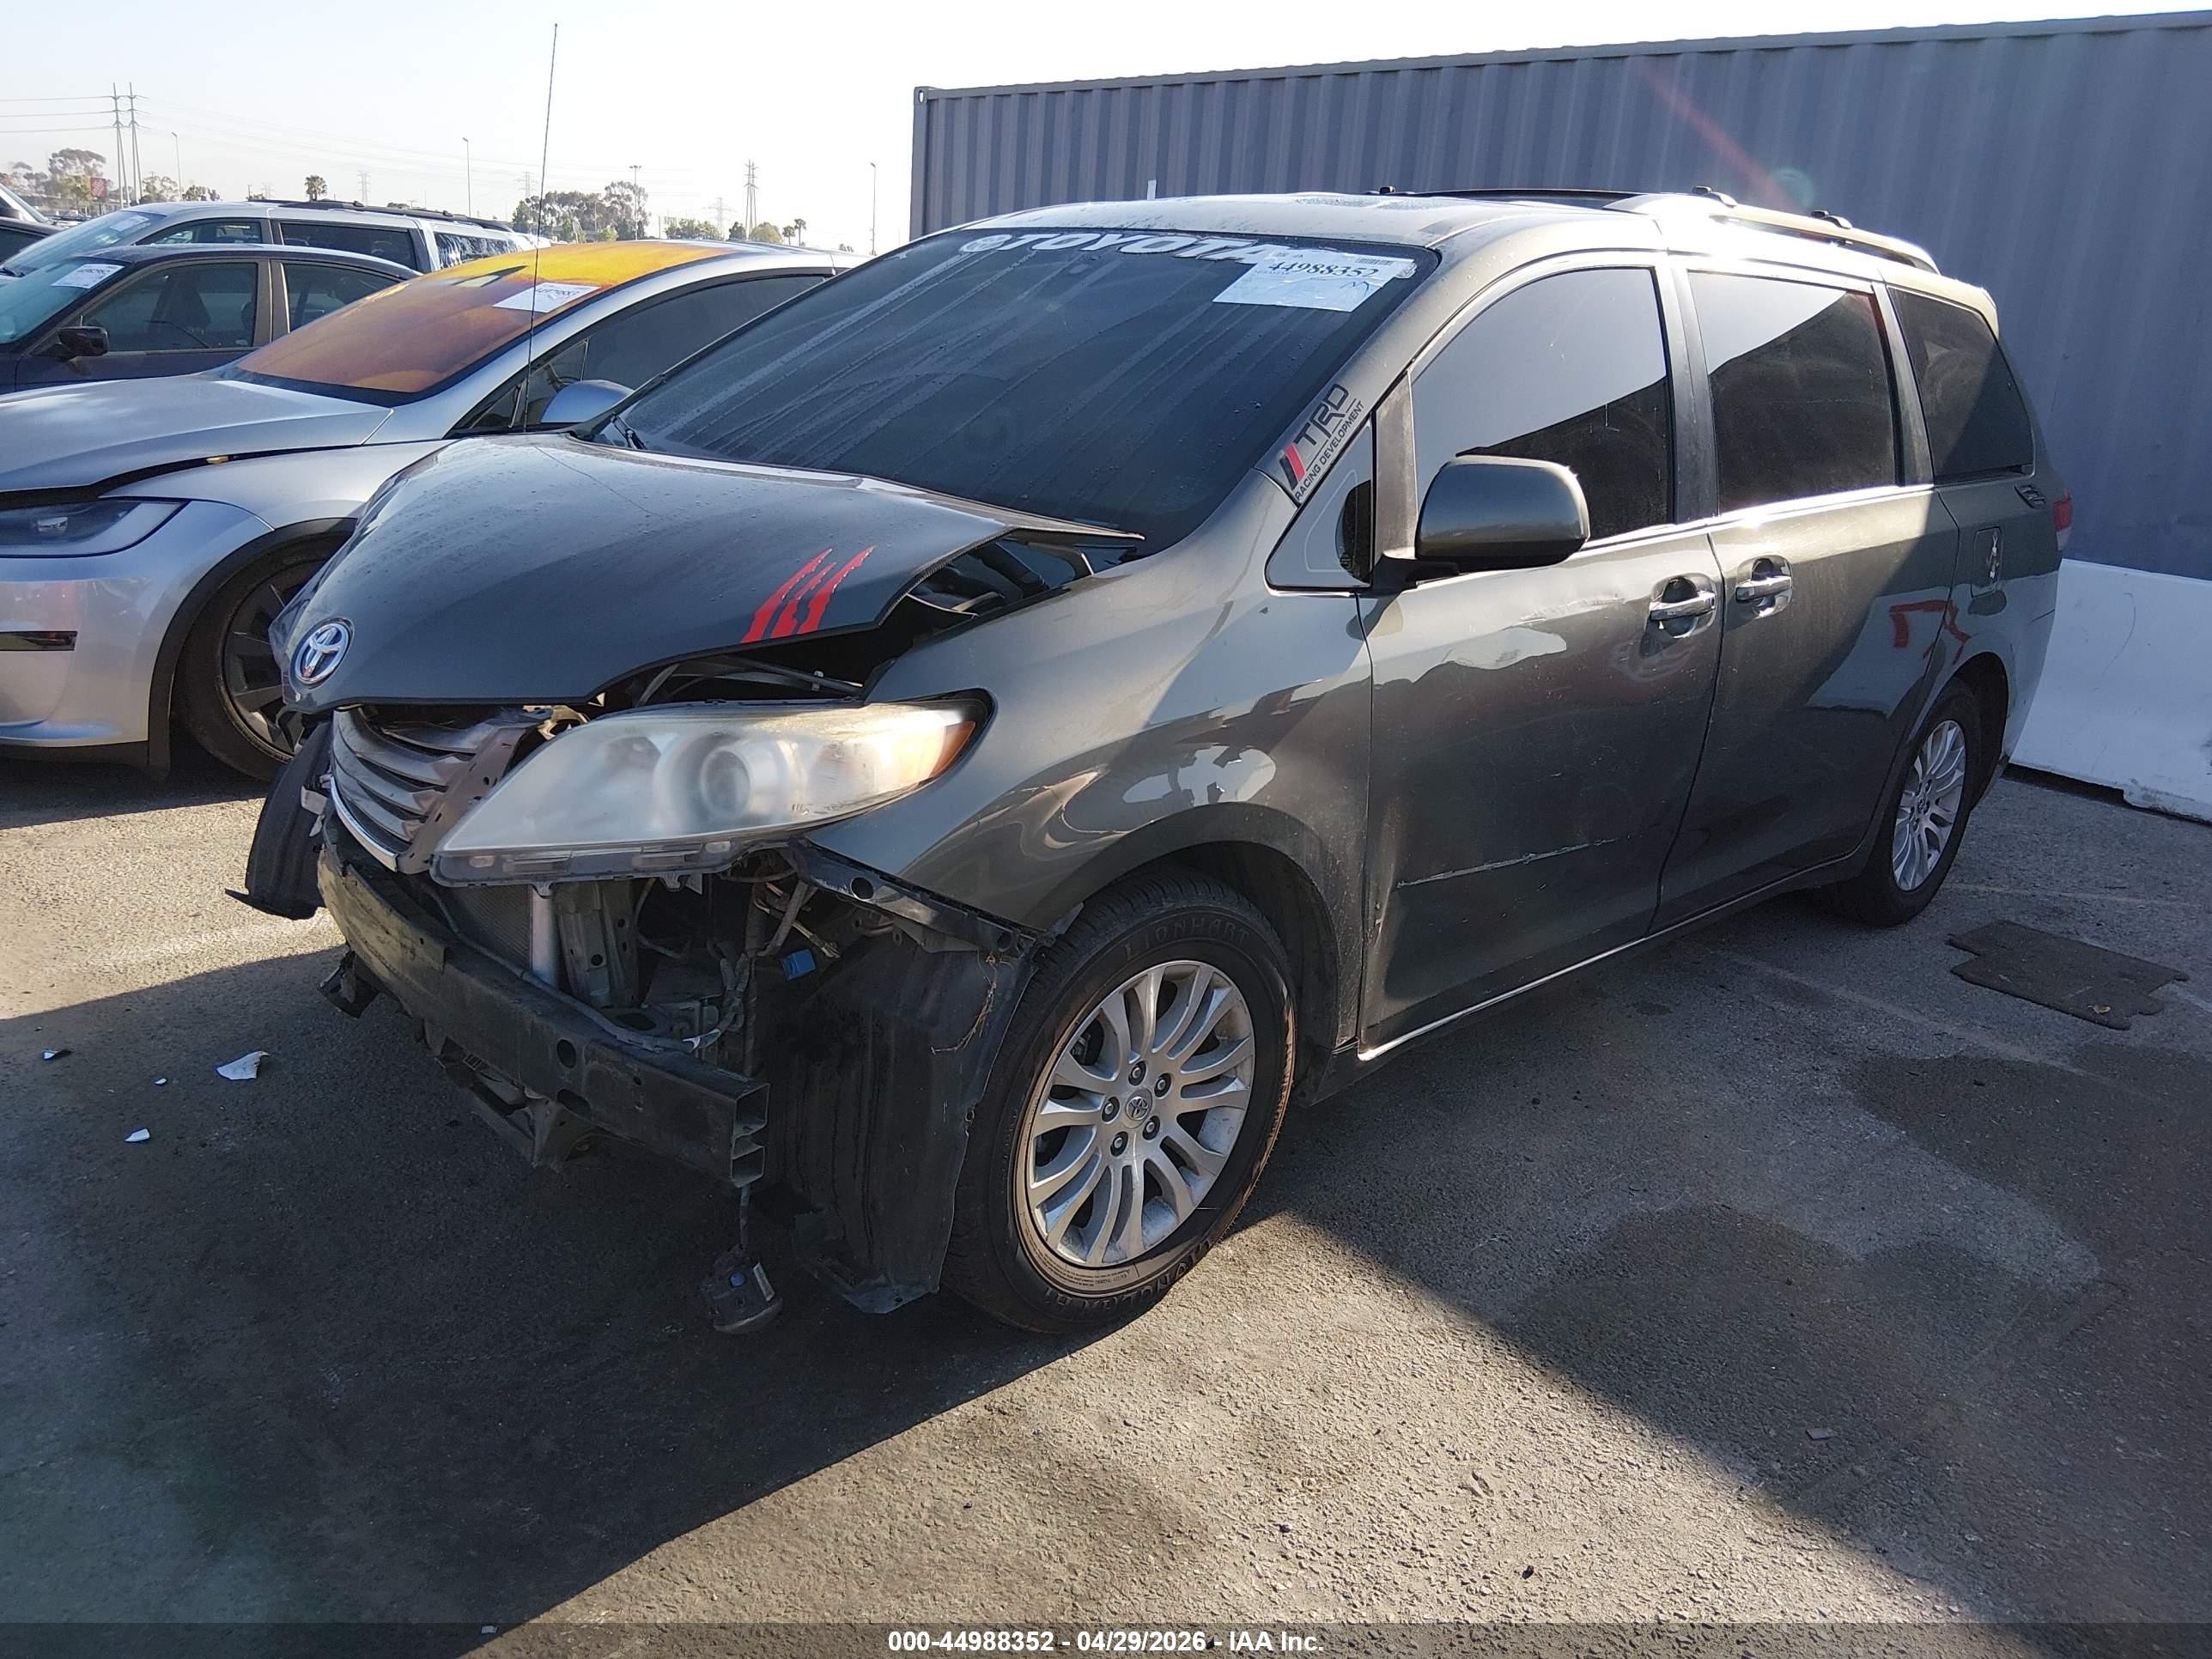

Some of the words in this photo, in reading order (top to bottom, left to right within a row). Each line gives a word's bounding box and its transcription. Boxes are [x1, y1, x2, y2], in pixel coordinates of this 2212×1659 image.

[997, 232, 1288, 264] TOYOTA
[1267, 261, 1380, 277] 44988352
[1293, 383, 1349, 446] TRD
[1295, 464, 1322, 501] RACING
[1320, 400, 1365, 466] DEVELOPMENT
[1125, 917, 1251, 960] LIONHART
